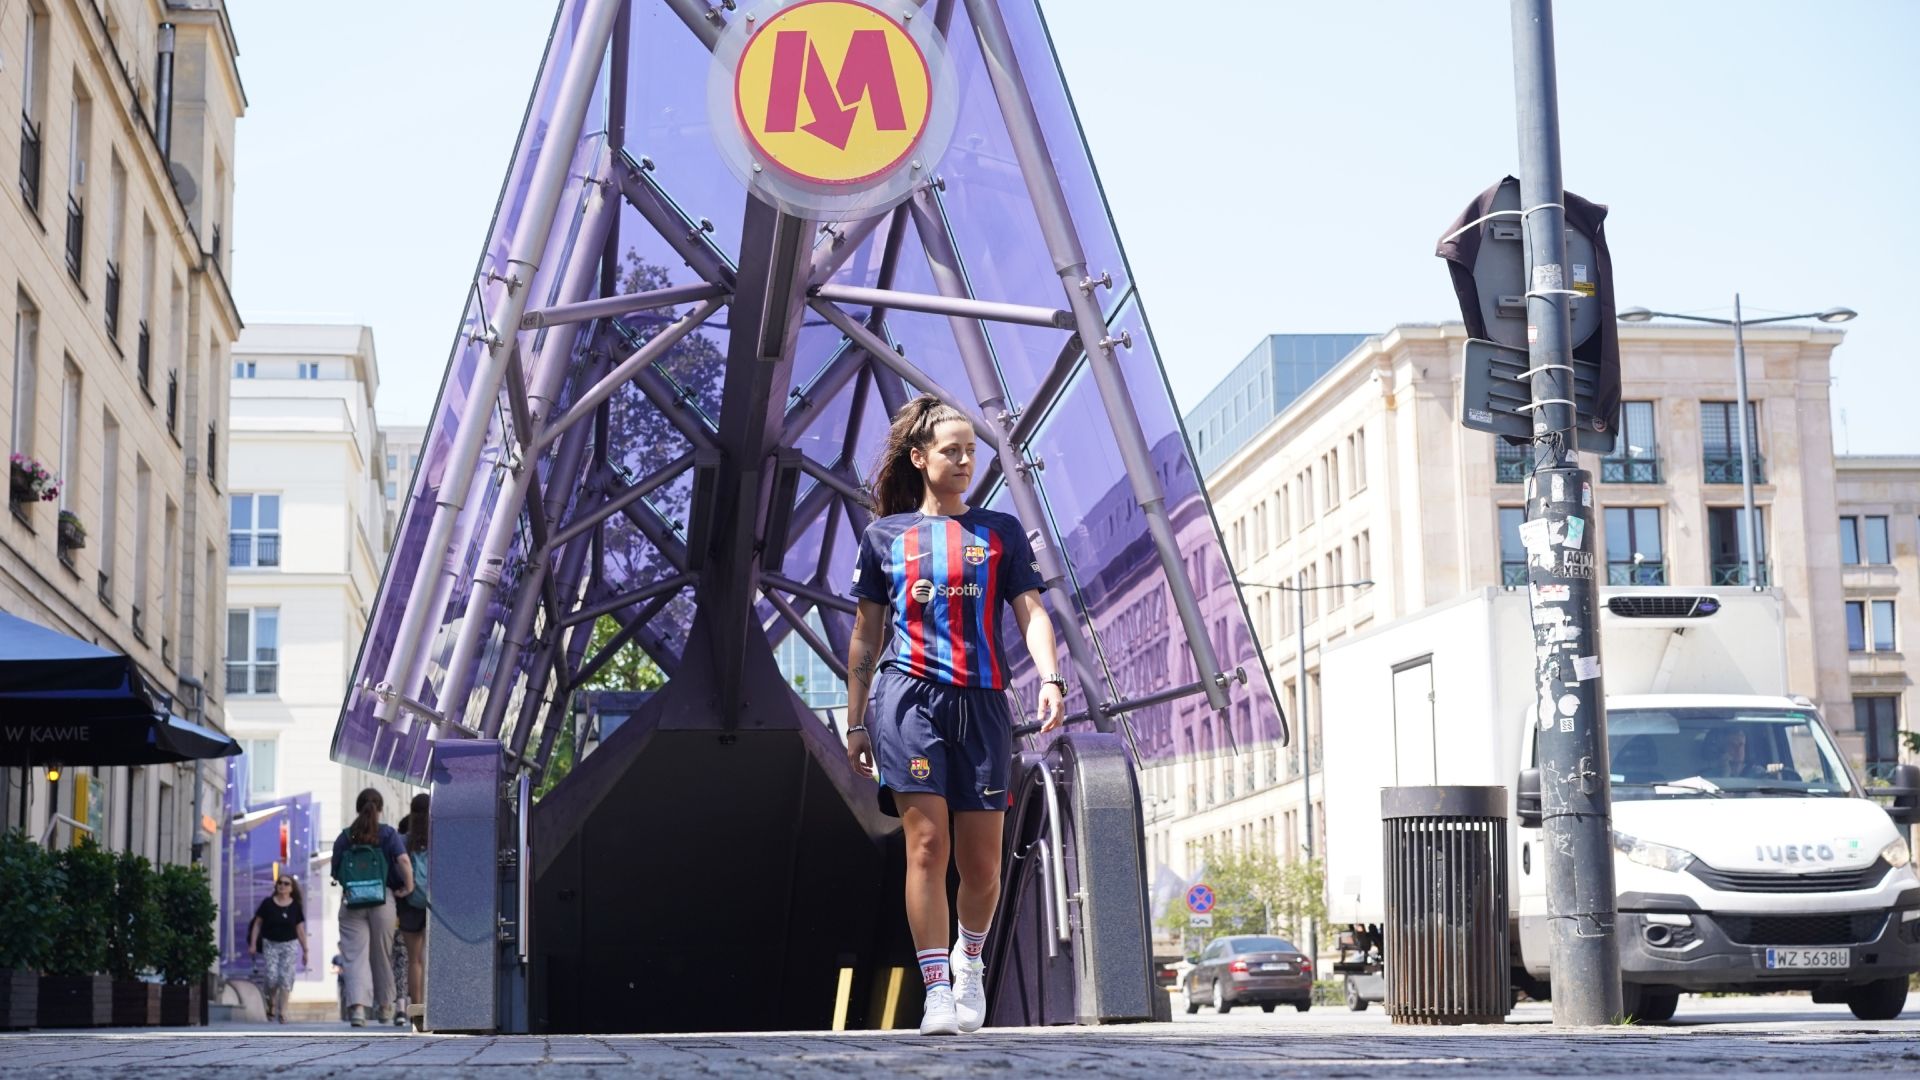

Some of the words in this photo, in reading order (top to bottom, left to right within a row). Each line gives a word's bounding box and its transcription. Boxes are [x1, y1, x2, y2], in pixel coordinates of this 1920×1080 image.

[764, 30, 907, 151] M
[937, 583, 983, 598] Spotify
[30, 725, 89, 742] KAWIE
[1756, 845, 1834, 863] IVECO
[1777, 951, 1798, 966] WZ
[1803, 951, 1848, 967] 5638U
